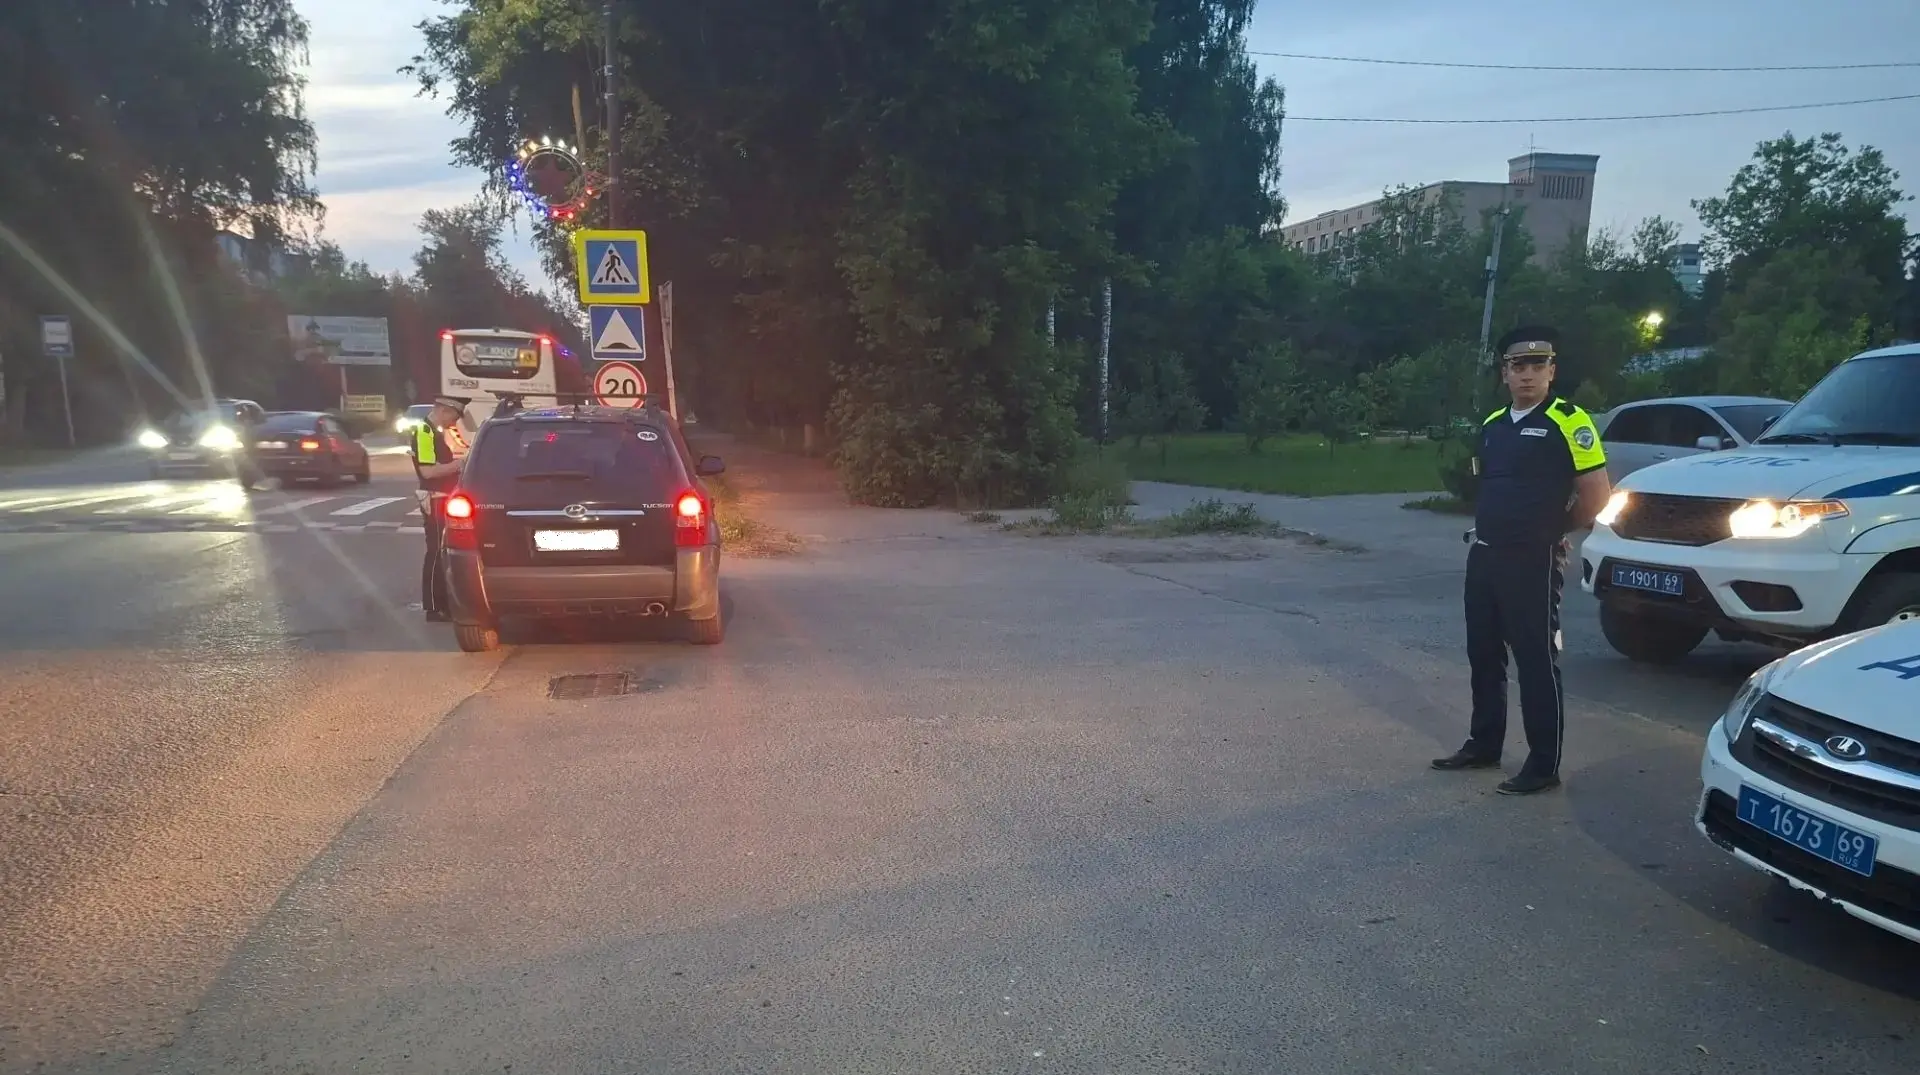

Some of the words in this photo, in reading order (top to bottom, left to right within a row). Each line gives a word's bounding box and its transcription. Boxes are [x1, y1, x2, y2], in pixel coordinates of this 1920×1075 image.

[604, 378, 637, 395] 20
[1694, 456, 1810, 467] ДПС
[1629, 570, 1657, 589] 1901
[1665, 574, 1678, 586] 69
[1748, 798, 1760, 820] Т
[1769, 805, 1824, 849] 1673
[1837, 830, 1866, 858] 69
[1838, 853, 1859, 869] RUS
